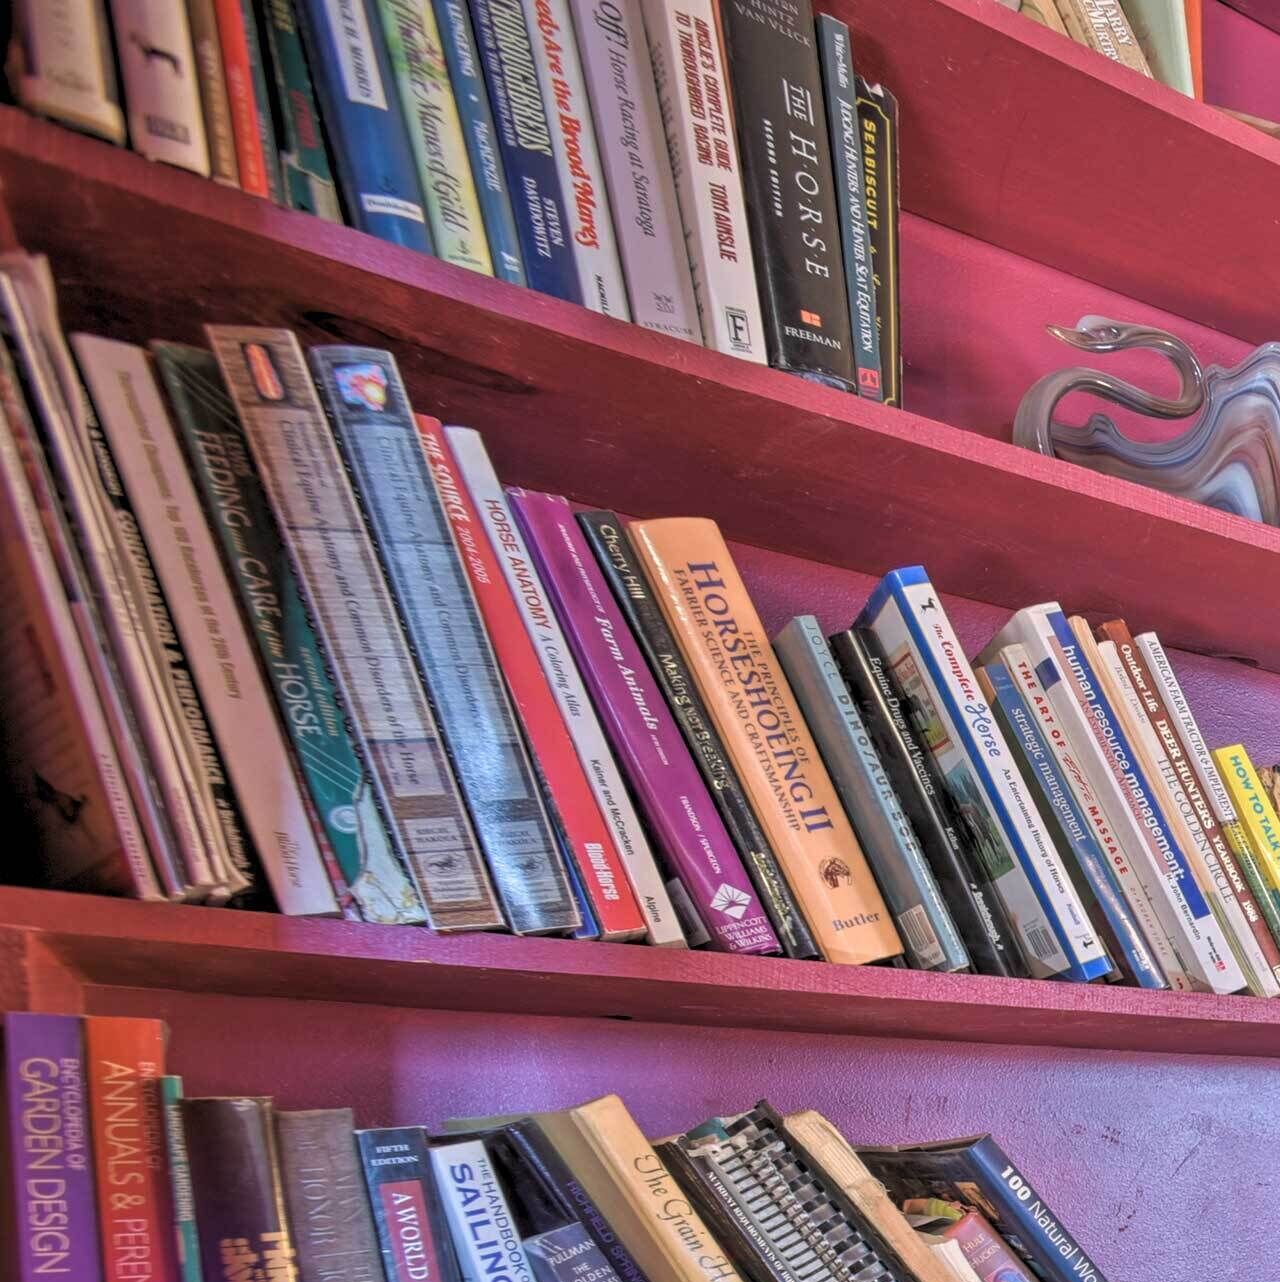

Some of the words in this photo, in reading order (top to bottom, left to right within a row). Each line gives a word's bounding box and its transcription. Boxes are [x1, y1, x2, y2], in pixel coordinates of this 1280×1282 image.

[675, 9, 692, 27] TO
[678, 28, 706, 120] THOROUGHBRED
[704, 73, 727, 137] COMPLETE
[790, 85, 807, 121] THE
[692, 121, 713, 166] RACING
[713, 137, 732, 173] GUIDE
[863, 119, 878, 230] SEABISCUIT
[542, 198, 565, 249] STEVEN
[708, 181, 731, 214] TOM
[849, 193, 862, 219] AND
[712, 213, 738, 263] AINSLIE
[850, 218, 866, 260] HUNTER
[855, 260, 869, 292] SEAT
[785, 326, 842, 350] FREEMAN
[858, 290, 873, 353] EQUITATION
[421, 432, 445, 461] THE
[432, 464, 471, 522] SOURCE
[193, 428, 251, 528] FEEDING
[239, 557, 283, 618] CARE
[271, 661, 323, 738] HORSE
[600, 524, 631, 576] Cherry
[624, 575, 647, 600] Hill
[484, 500, 520, 553] HORSE
[509, 556, 553, 629] ANATOMY
[547, 646, 568, 689] Coloring
[562, 691, 582, 717] Atlas
[674, 570, 709, 629] FARRIER
[703, 629, 736, 689] SCIENCE
[730, 690, 750, 719] AND
[744, 717, 802, 833] CRAFTSMANSHIP
[687, 560, 815, 804] HORSESHOEING
[799, 805, 835, 835] II
[743, 631, 762, 658] THE
[757, 662, 800, 750] PRINCIPLES
[796, 745, 811, 766] OF
[1062, 645, 1097, 704] human
[1092, 704, 1132, 770] resource
[1011, 708, 1046, 761] strategic
[1039, 760, 1088, 843] management
[1018, 661, 1038, 689] THE
[1033, 696, 1055, 725] ART
[1052, 730, 1068, 751] OF
[1088, 806, 1130, 876] MASSAGE
[1121, 643, 1147, 691] Outdoor
[1142, 688, 1160, 714] Life
[1156, 718, 1182, 761] DEER
[1175, 760, 1216, 830] HUNTERS
[1212, 835, 1246, 893] YEARBOOK
[1158, 758, 1175, 791] THE
[1174, 789, 1209, 854] GOLDEN
[1204, 853, 1234, 905] CIRCLE
[1229, 754, 1256, 794] HOW
[1248, 794, 1266, 816] TO
[1259, 816, 1280, 853] TALK
[590, 758, 607, 788] Kainer
[603, 787, 616, 807] and
[610, 801, 635, 856] McCracken
[645, 896, 662, 923] Alpine
[832, 909, 881, 933] Butler
[20, 1057, 65, 1170] GARDEN
[60, 1058, 84, 1150] ENCYCLOPEDIA
[101, 1060, 146, 1186] ANNUALS
[67, 1153, 87, 1171] OF
[371, 1155, 419, 1167] EDITION
[476, 1159, 492, 1181] THE
[26, 1178, 72, 1274] DESIGN
[110, 1193, 146, 1210] &
[391, 1192, 414, 1205] A
[483, 1180, 528, 1275] HANDBOOK
[635, 1153, 669, 1197] The
[656, 1198, 706, 1254] Grain
[1001, 1165, 1033, 1202] 100
[1029, 1200, 1077, 1262] Natural
[394, 1207, 432, 1281] WORLD
[549, 1240, 595, 1267] PULLMAN
[572, 1262, 592, 1274] THE
